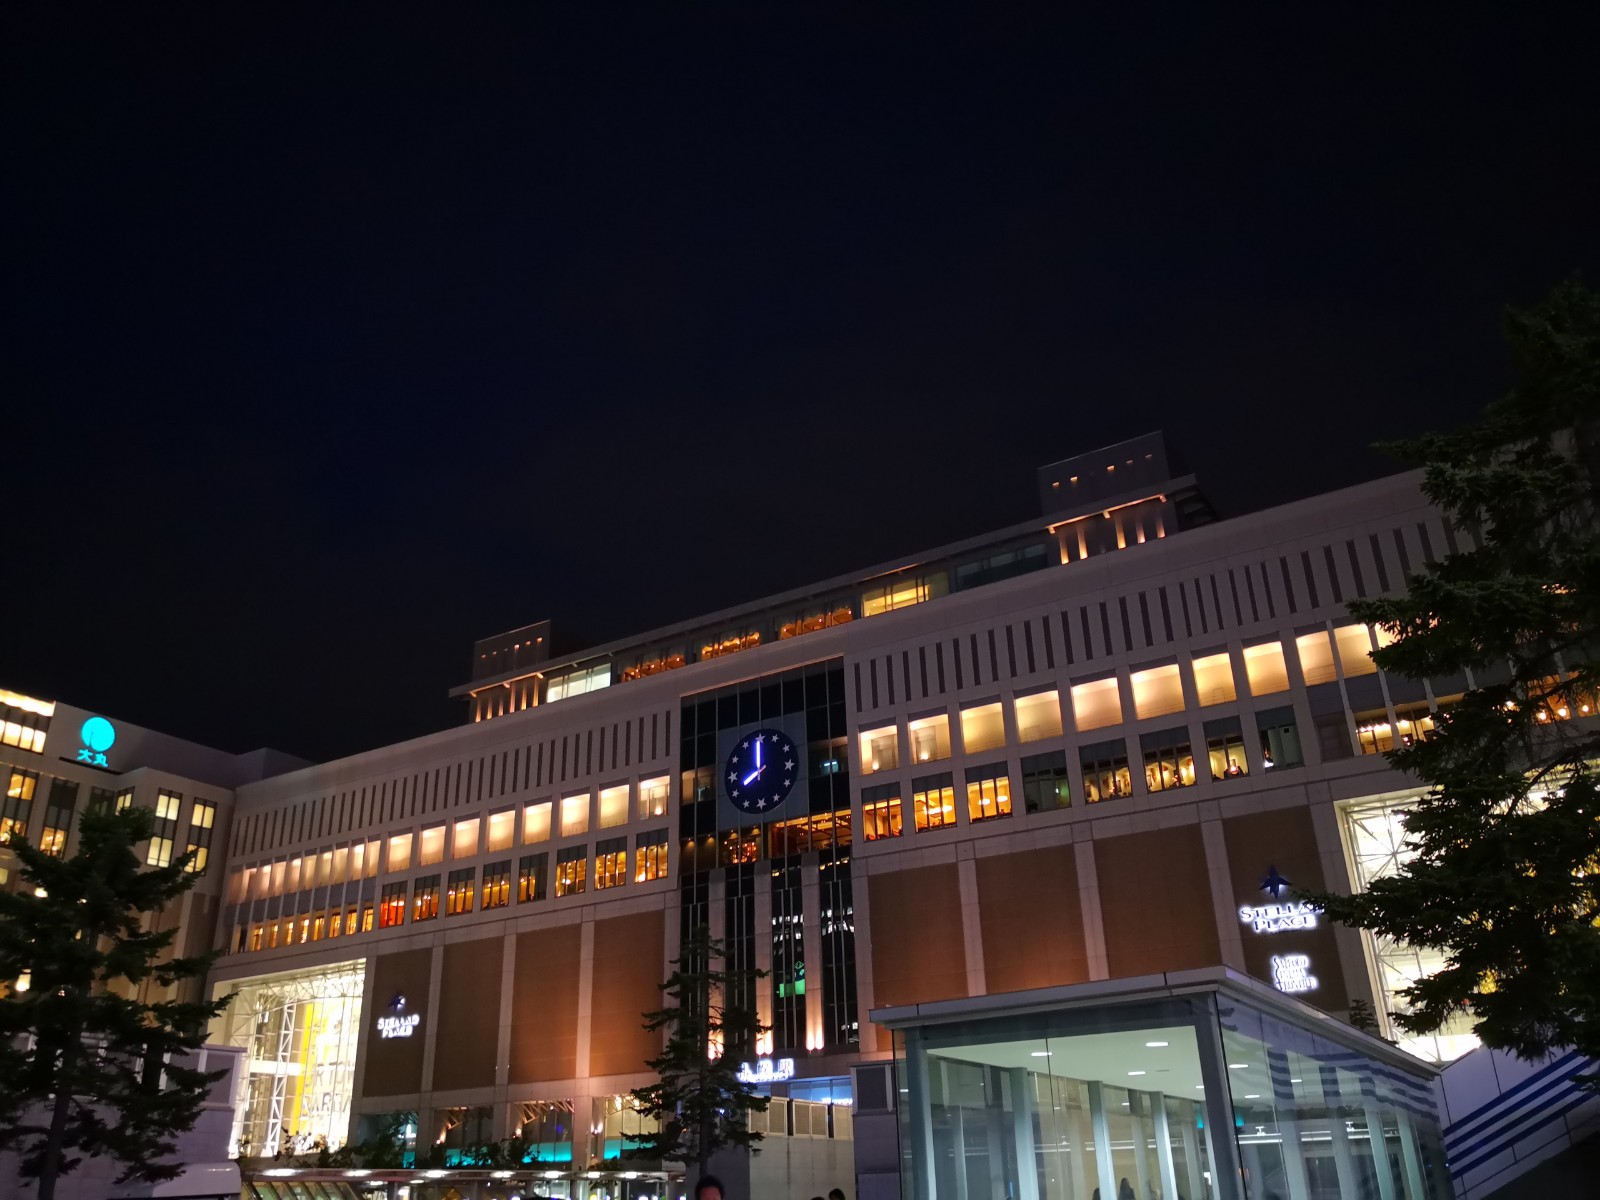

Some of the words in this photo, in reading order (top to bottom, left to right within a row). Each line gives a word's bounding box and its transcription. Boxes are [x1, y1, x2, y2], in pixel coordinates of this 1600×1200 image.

[77, 749, 109, 768] 大丸
[1240, 901, 1325, 920] STELLA
[1253, 915, 1312, 931] PLACE
